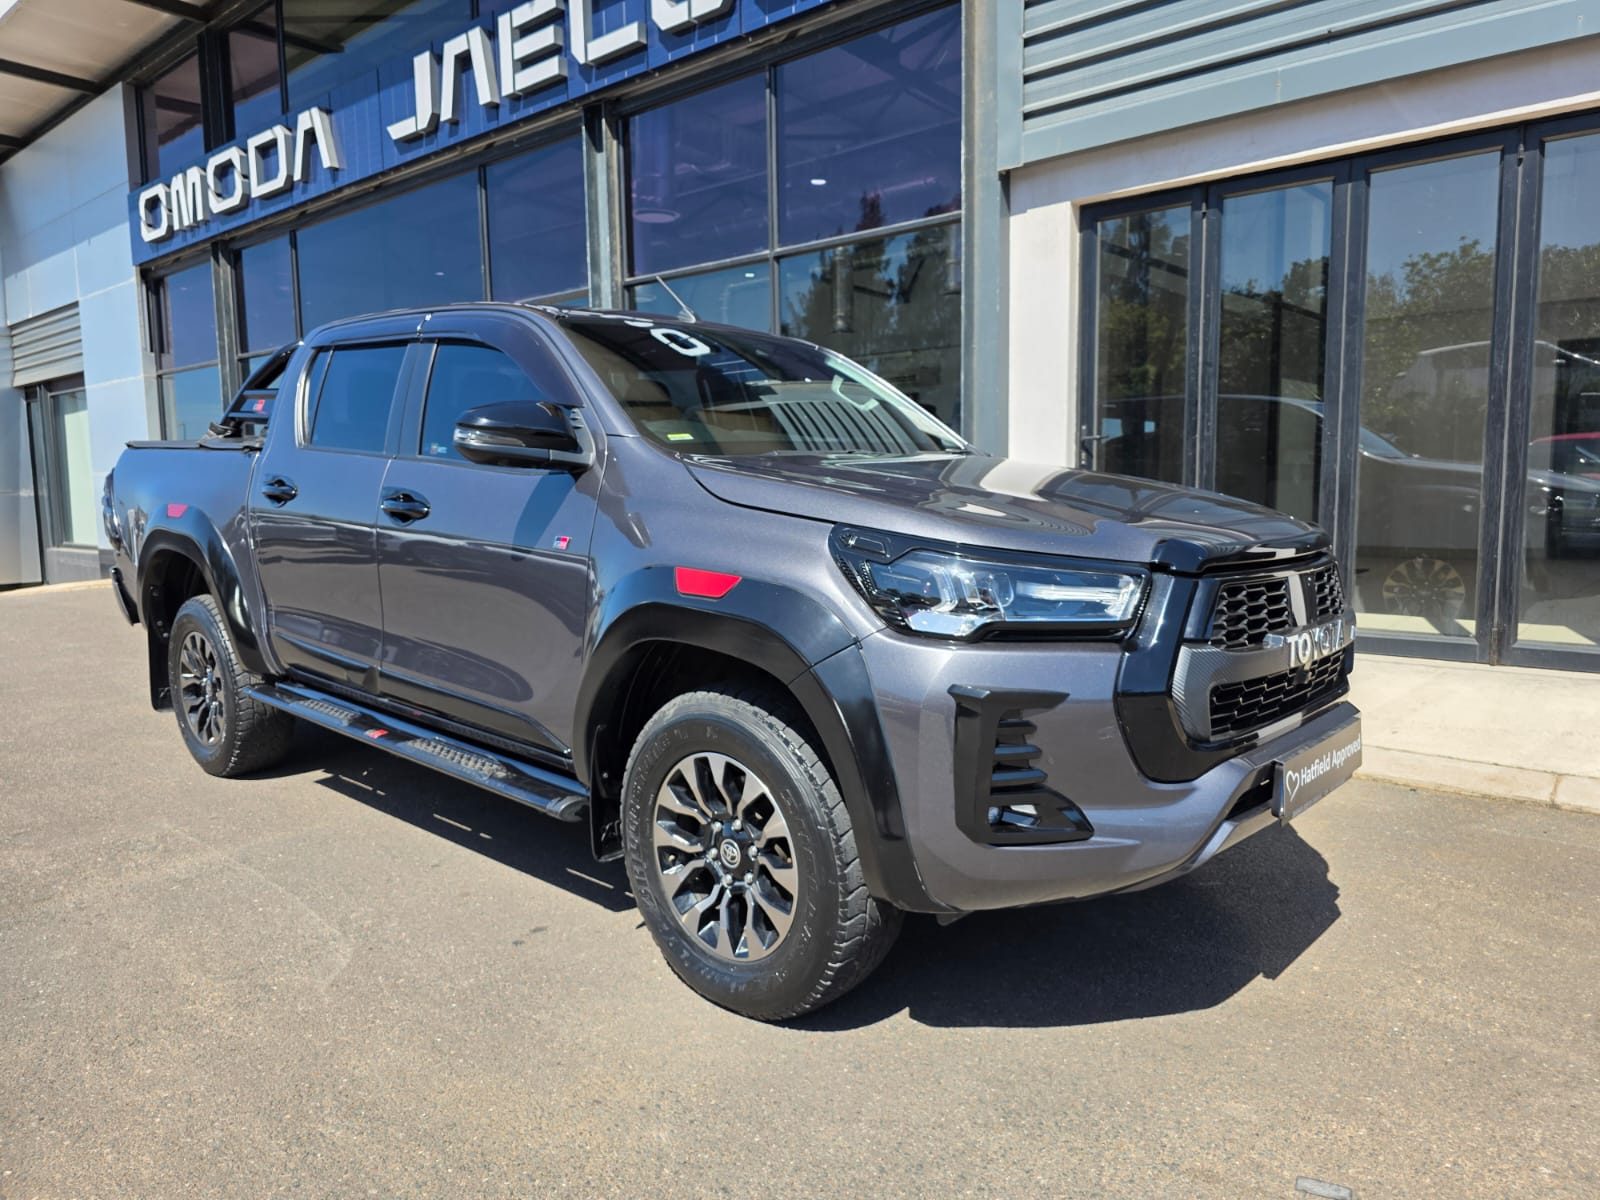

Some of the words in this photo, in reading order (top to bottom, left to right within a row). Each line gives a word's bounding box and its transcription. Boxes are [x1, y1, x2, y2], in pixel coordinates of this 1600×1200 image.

[138, 106, 339, 243] OMODA
[1286, 619, 1344, 668] TOYOTA
[1301, 751, 1331, 787] Hatfield
[1332, 733, 1361, 768] Approved
